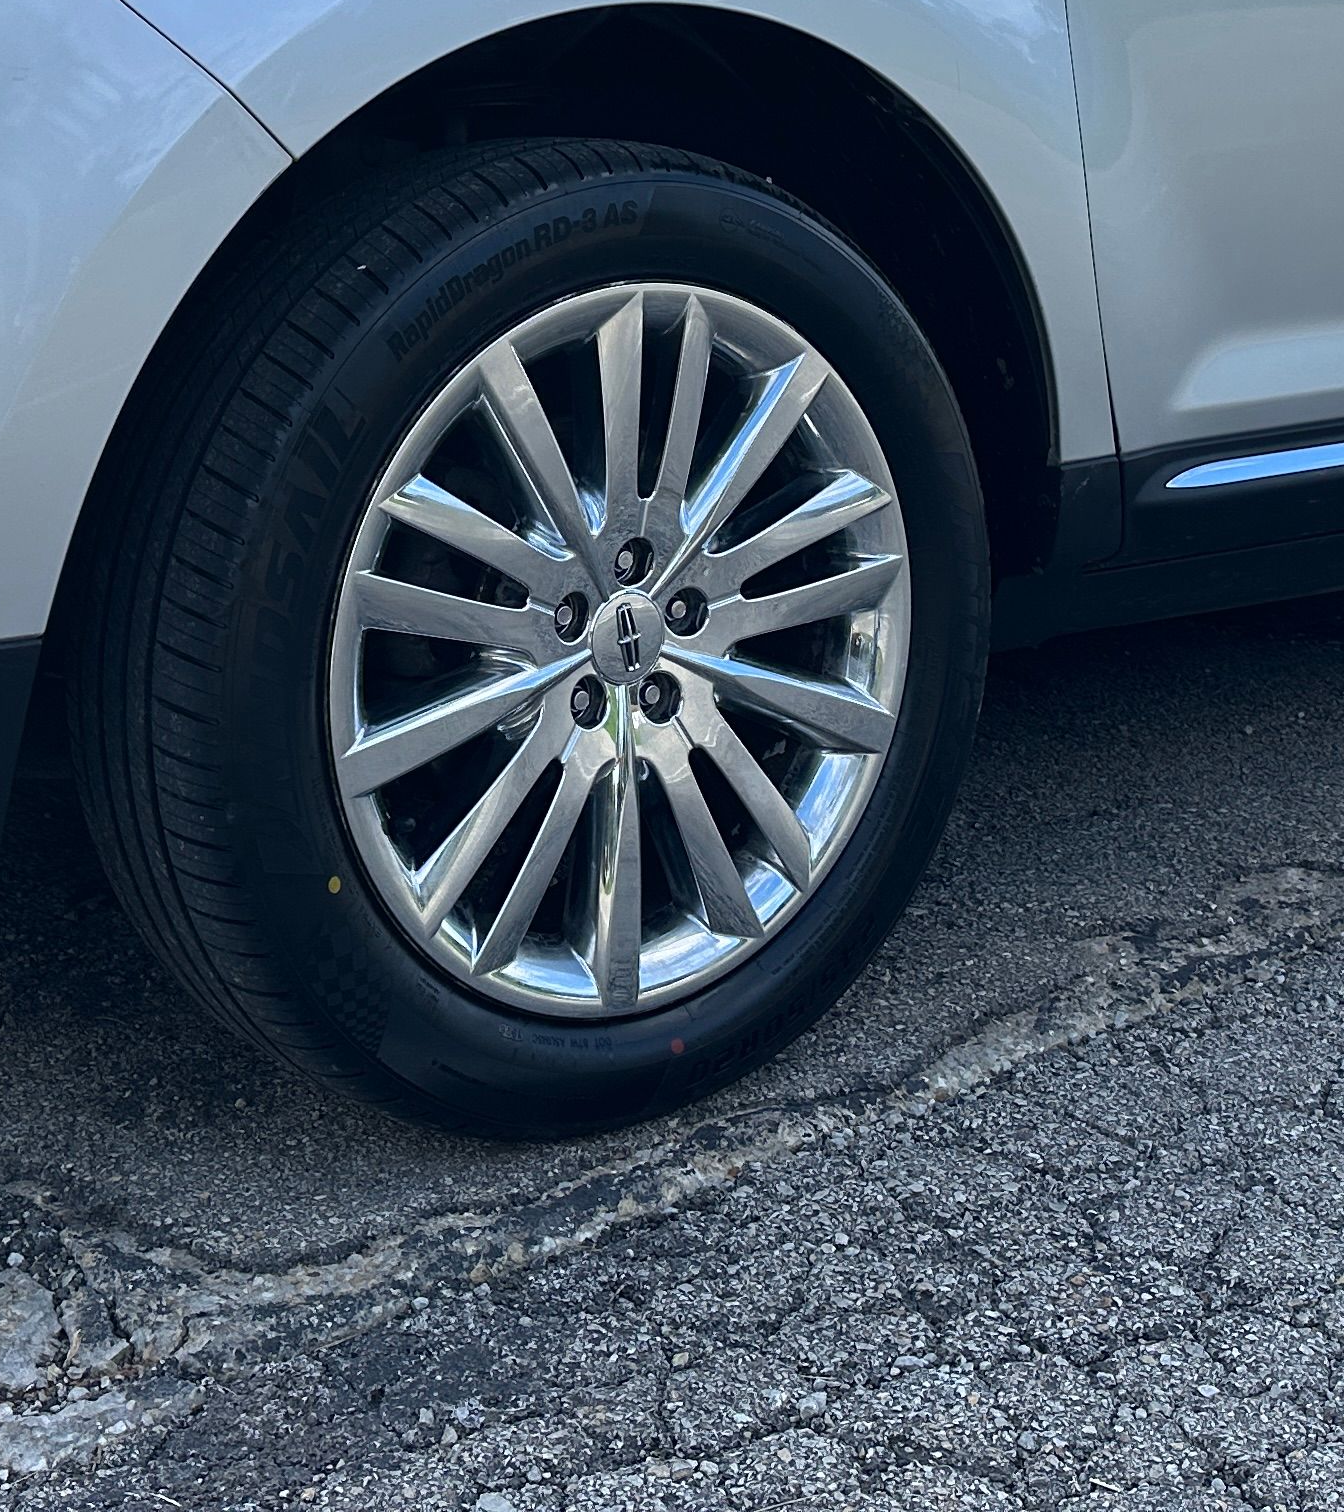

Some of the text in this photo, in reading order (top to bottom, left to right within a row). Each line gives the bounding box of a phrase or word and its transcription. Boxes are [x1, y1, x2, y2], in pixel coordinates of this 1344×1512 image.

[385, 199, 640, 362] RapidDragon RD-3 AS
